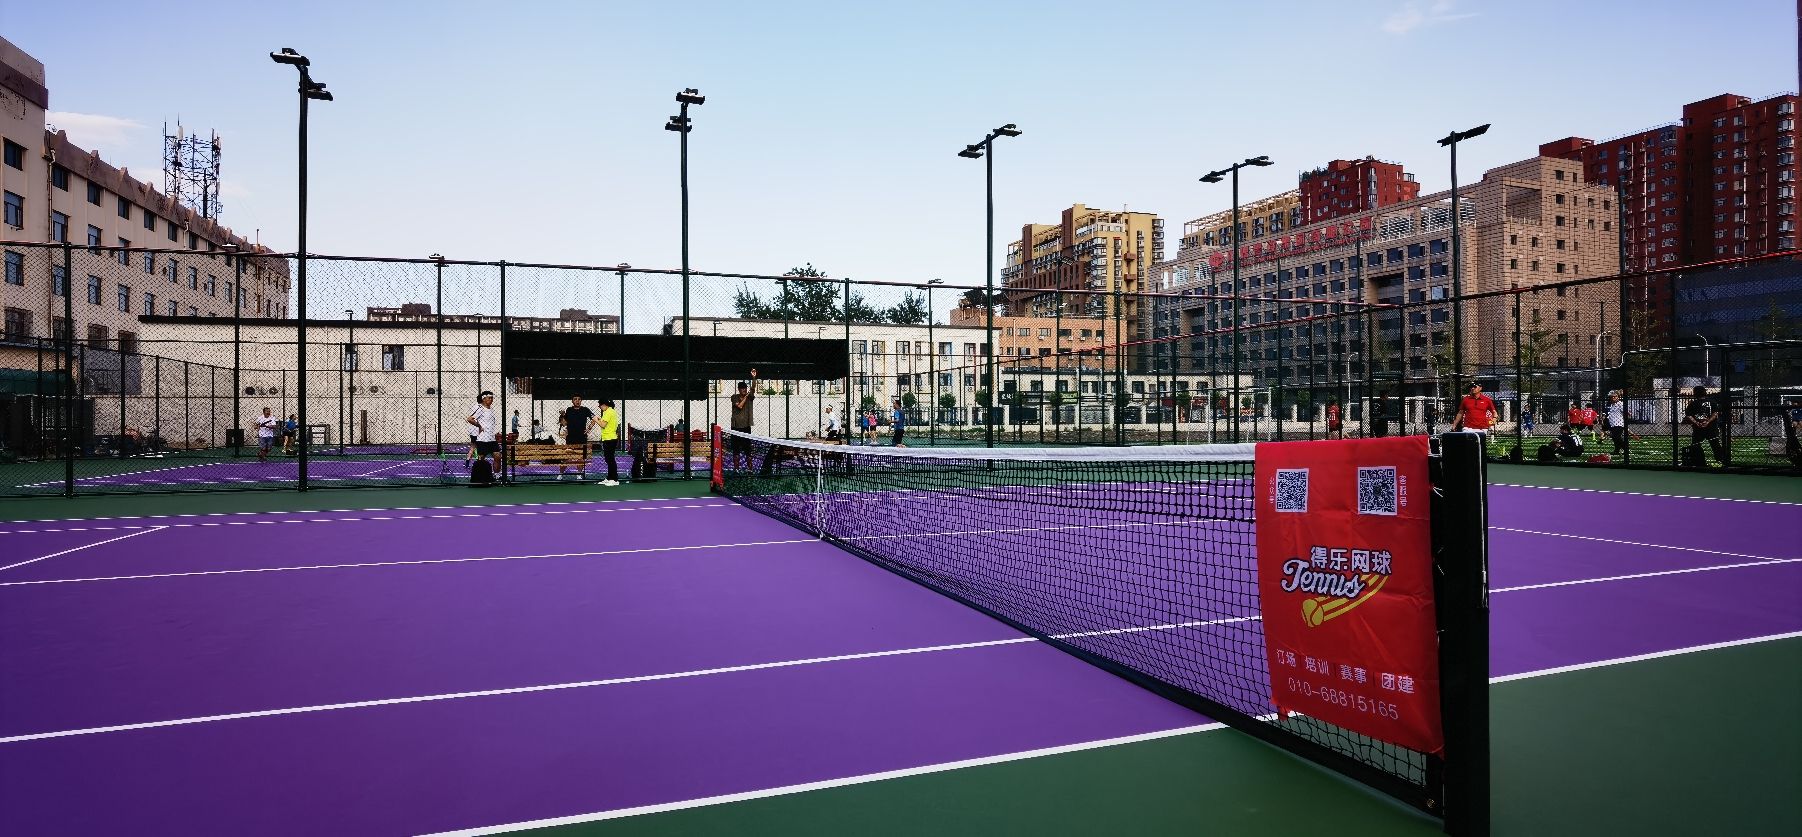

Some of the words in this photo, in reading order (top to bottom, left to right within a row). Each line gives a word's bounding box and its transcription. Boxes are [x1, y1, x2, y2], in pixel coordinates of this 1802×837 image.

[1280, 559, 1366, 598] Tennis
[1310, 546, 1392, 575] 得乐网球
[1276, 648, 1297, 668] 订场
[1304, 655, 1330, 676] 培训
[1340, 664, 1367, 684] 赛事
[1381, 672, 1415, 694] 团建
[1288, 677, 1399, 720] 010-68815165
